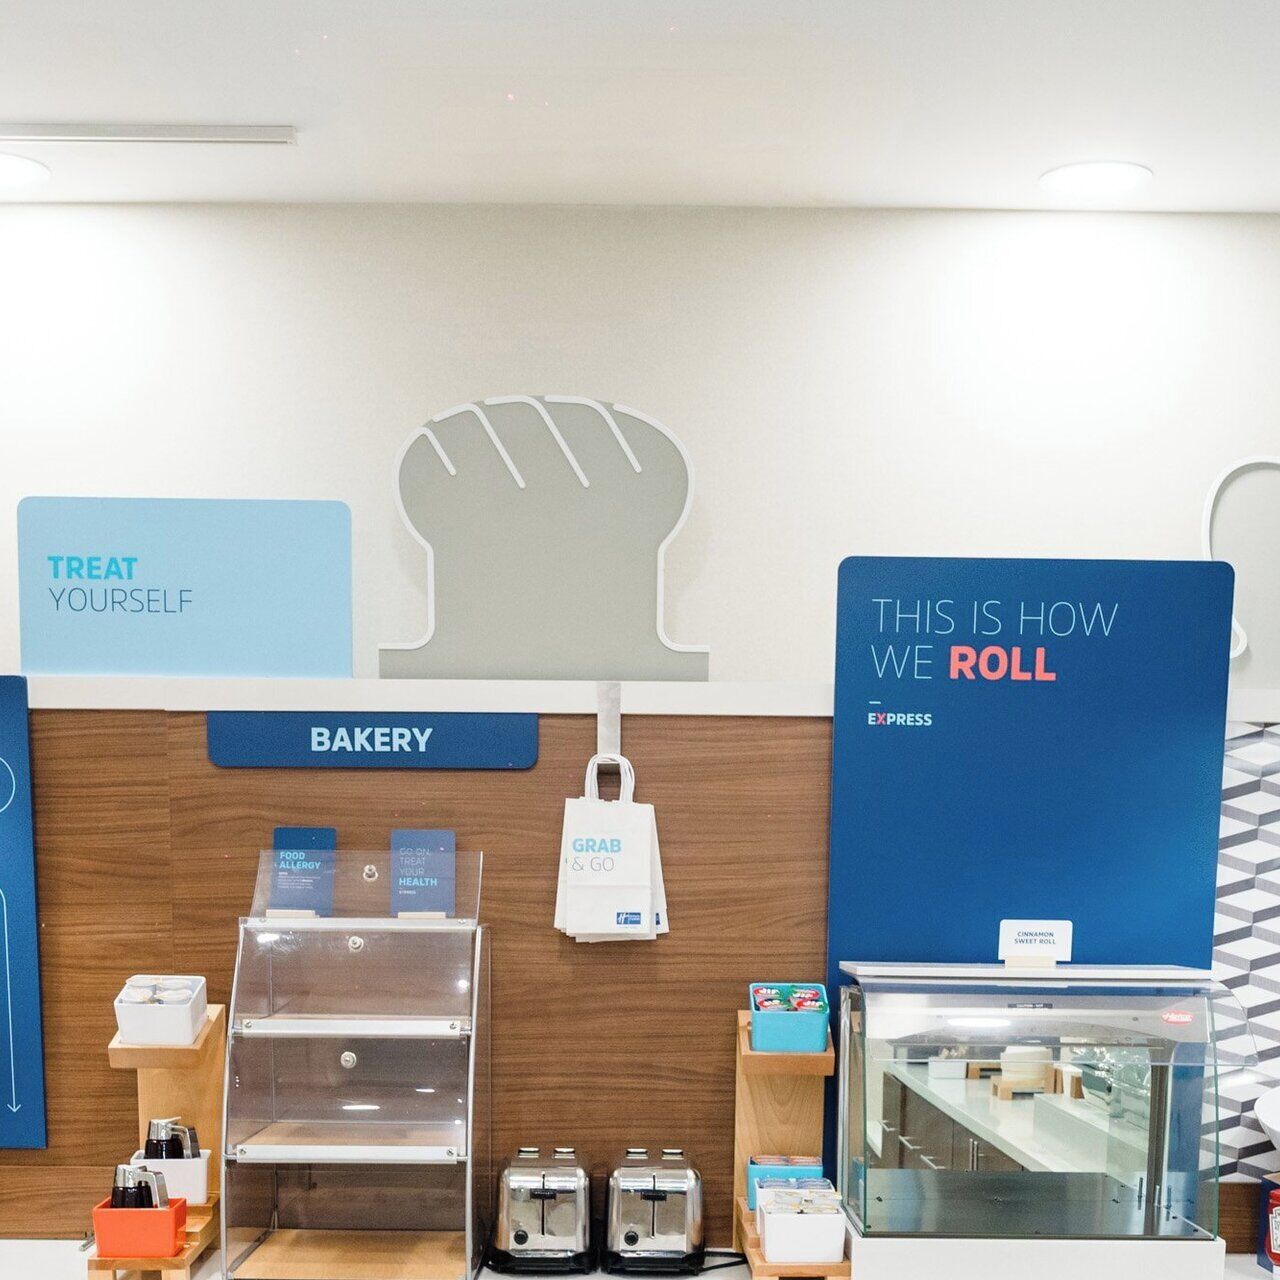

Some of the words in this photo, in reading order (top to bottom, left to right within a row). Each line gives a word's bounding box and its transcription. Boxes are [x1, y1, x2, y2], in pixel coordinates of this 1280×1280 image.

[47, 555, 138, 580] TREAT
[48, 587, 193, 613] YOURSELF
[872, 598, 955, 635] THIS
[972, 600, 1003, 635] IS
[1019, 601, 1119, 637] HOW
[870, 644, 934, 680] WE
[949, 645, 1057, 682] ROLL
[867, 712, 933, 727] EXPRESS
[310, 726, 434, 752] BAKERY
[572, 837, 622, 854] GRAB
[280, 851, 306, 860] FOOD
[571, 856, 585, 872] &
[590, 856, 616, 872] GO
[279, 860, 322, 870] ALLERGY
[398, 877, 438, 887] HEALTH
